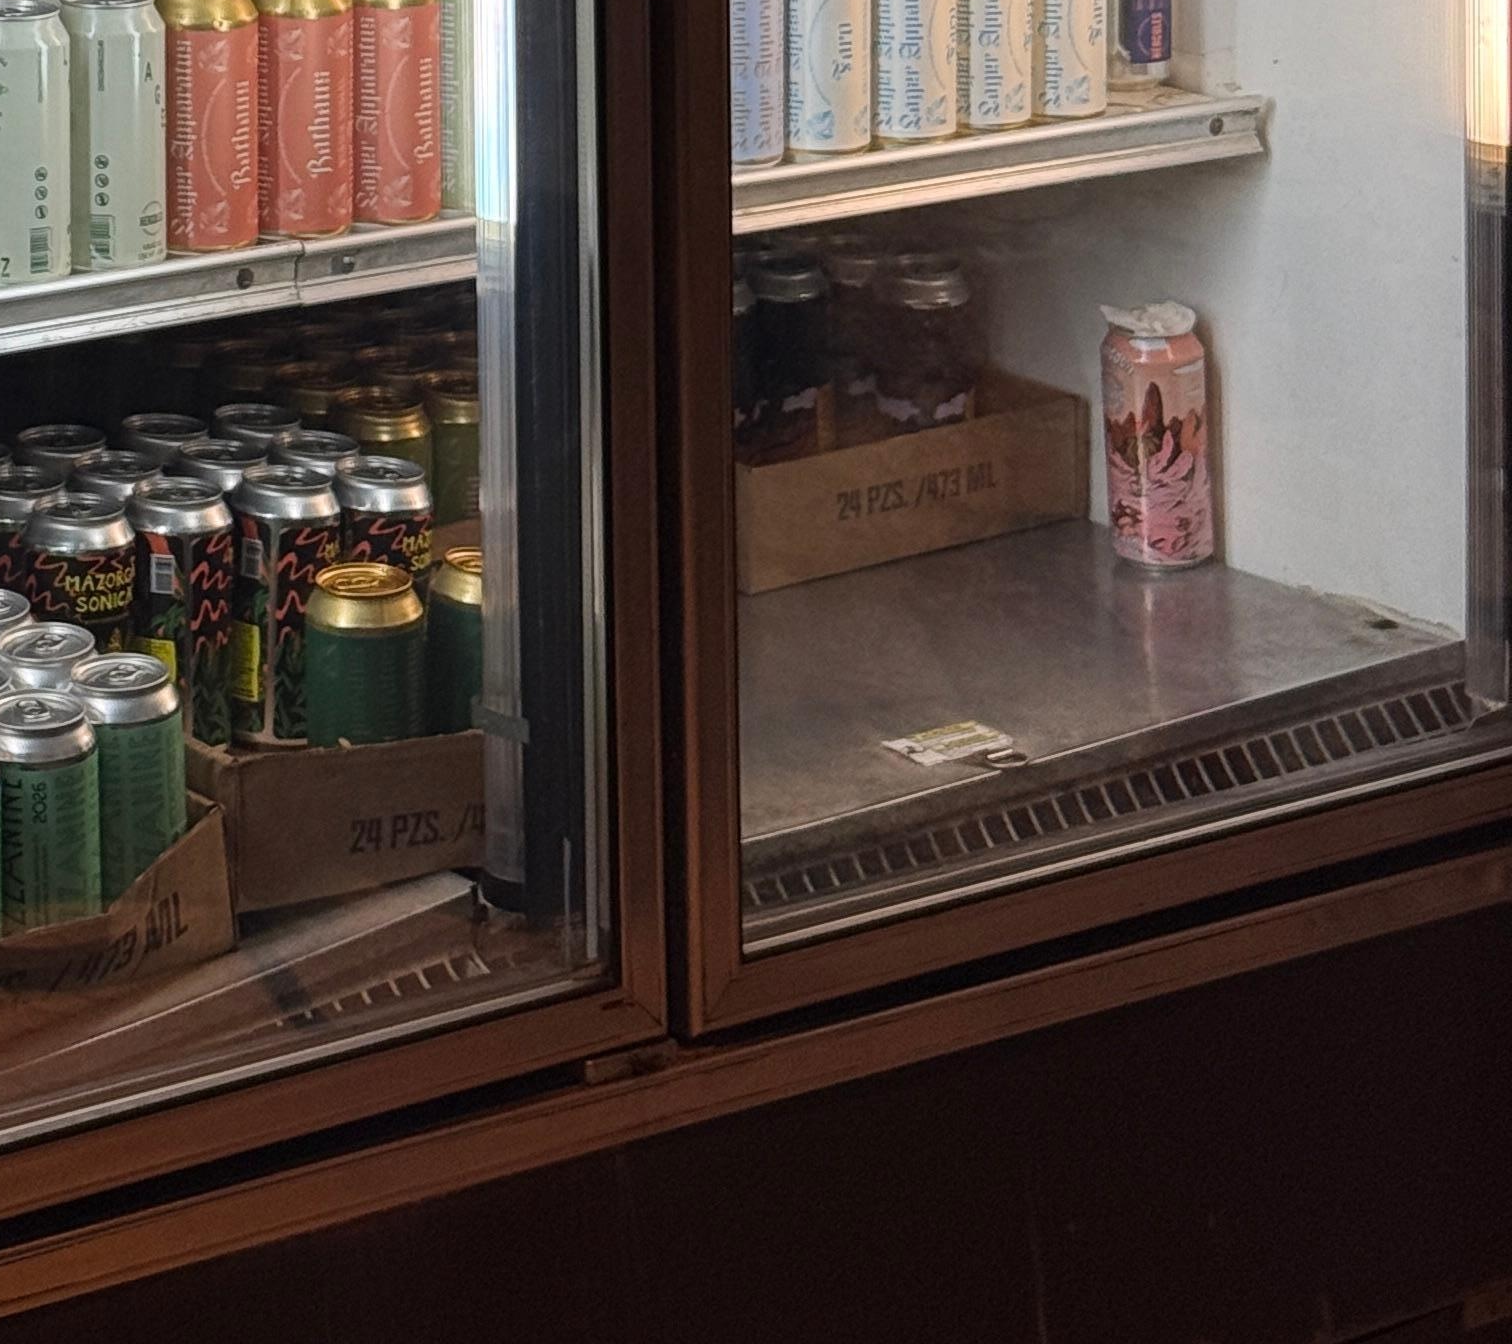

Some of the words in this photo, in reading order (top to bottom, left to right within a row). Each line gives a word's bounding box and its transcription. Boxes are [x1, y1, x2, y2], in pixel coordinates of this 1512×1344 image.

[306, 70, 333, 179] Rathaus
[836, 490, 861, 523] 24
[31, 781, 48, 825] 2026
[349, 816, 383, 854] 24
